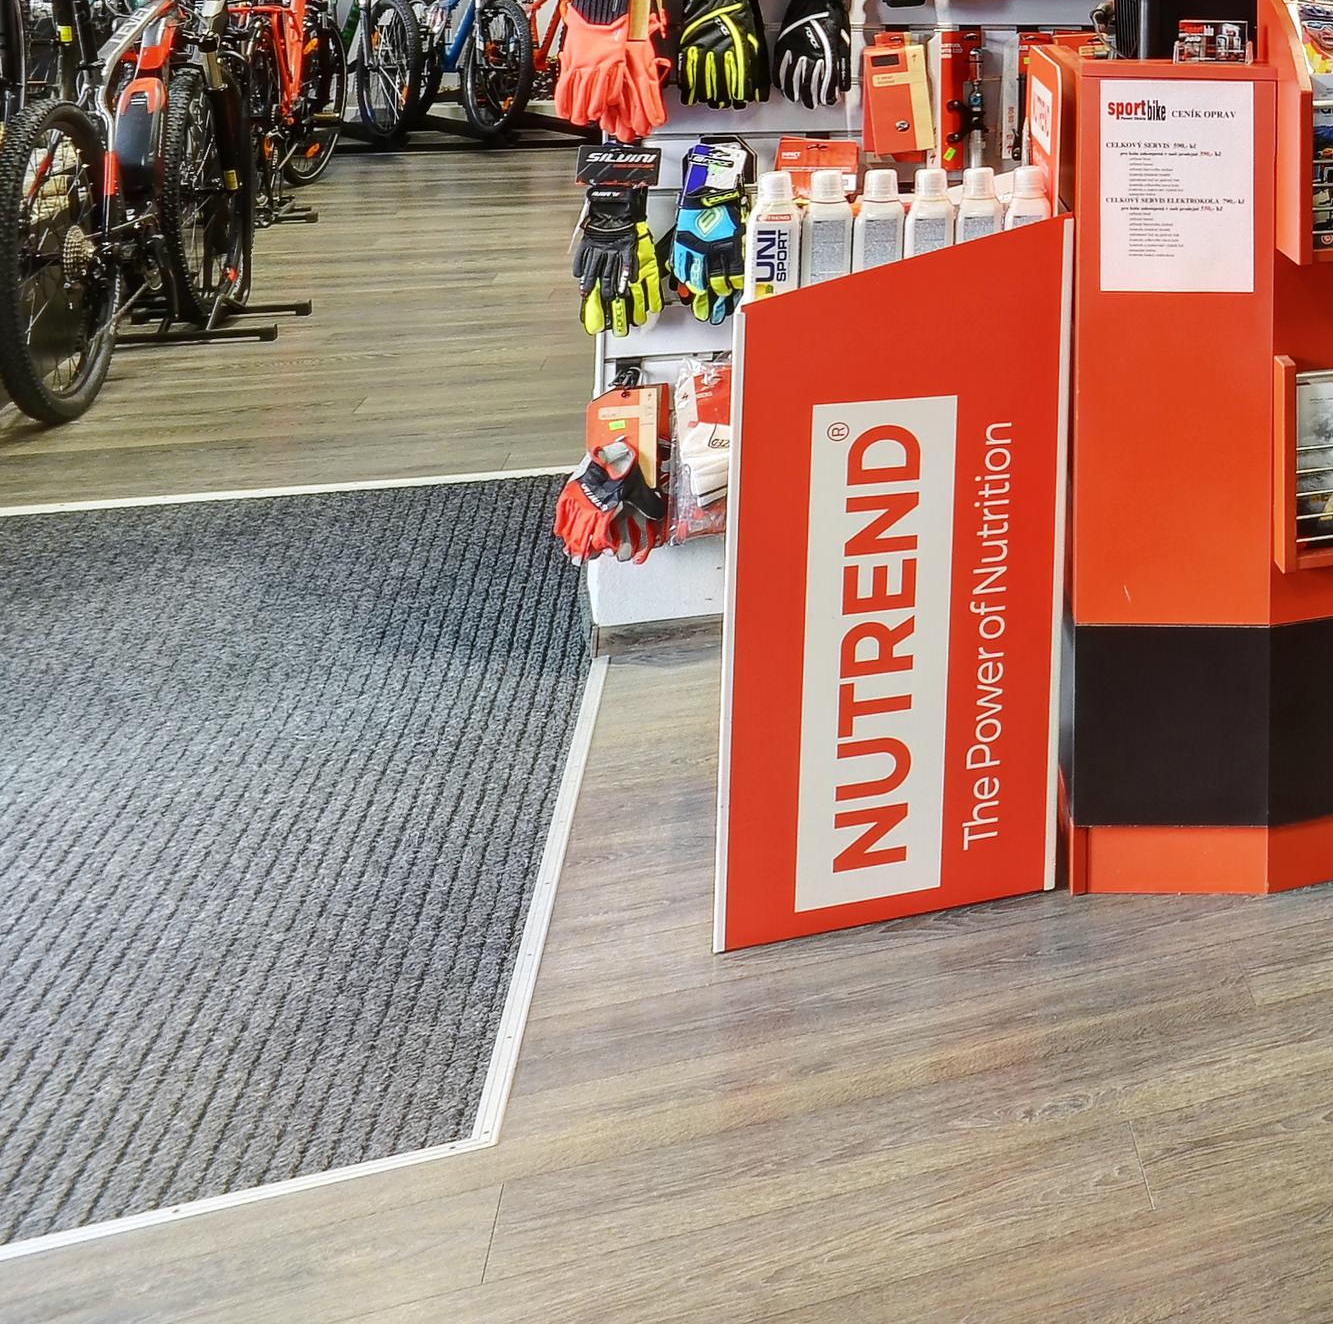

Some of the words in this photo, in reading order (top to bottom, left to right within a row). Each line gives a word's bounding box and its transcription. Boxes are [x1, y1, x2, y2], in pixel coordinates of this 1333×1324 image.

[1107, 100, 1167, 121] sportbike
[1171, 110, 1201, 119] CENÍK
[1203, 111, 1237, 119] OPRAV
[586, 152, 657, 164] SILVINI
[1106, 140, 1142, 149] CELKOVÝ
[755, 229, 777, 283] UNI
[776, 230, 789, 282] SPORT
[971, 420, 1013, 593] Nutrition
[832, 422, 922, 874] NUTREND
[969, 601, 1006, 647] of
[966, 656, 1005, 770] Power
[962, 779, 1000, 852] The
